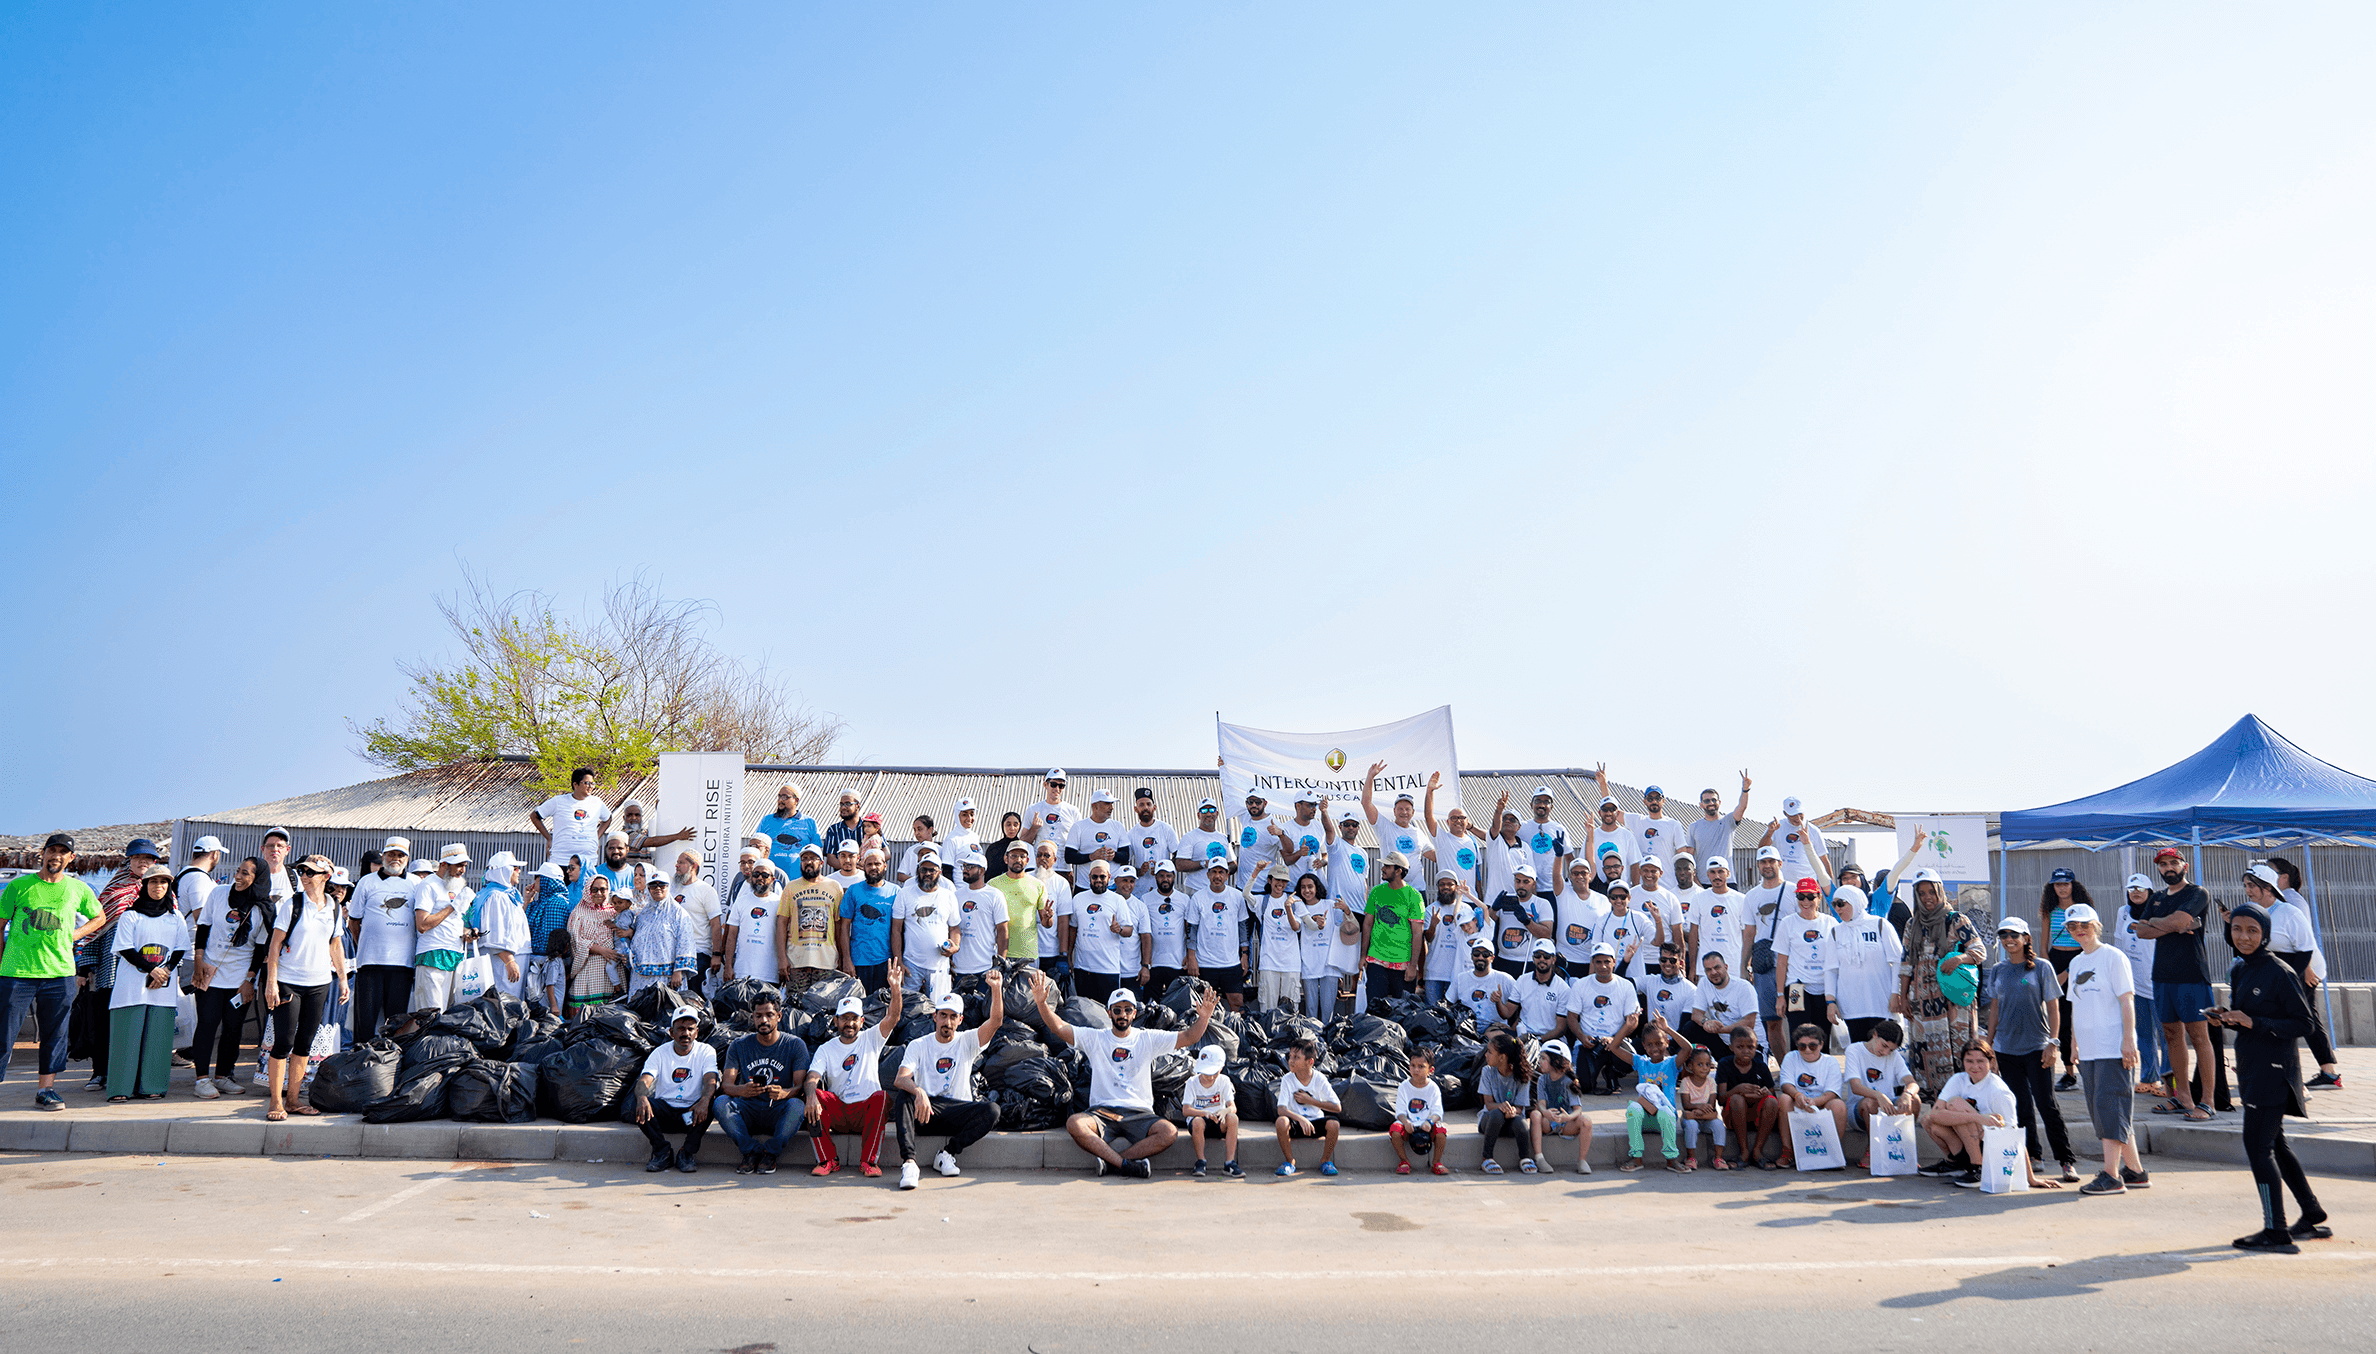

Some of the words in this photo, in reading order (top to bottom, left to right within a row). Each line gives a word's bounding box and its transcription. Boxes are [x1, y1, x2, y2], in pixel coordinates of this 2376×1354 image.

[705, 779, 720, 820] RISE
[724, 780, 733, 824] INITIATIVE
[702, 827, 718, 888] OJECT
[722, 826, 731, 859] BOHRA
[720, 861, 728, 905] DAWOODI
[792, 889, 818, 900] SURFERS
[822, 891, 835, 902] CLUB
[747, 1058, 770, 1071] SAILING
[770, 1059, 785, 1072] CLUB
